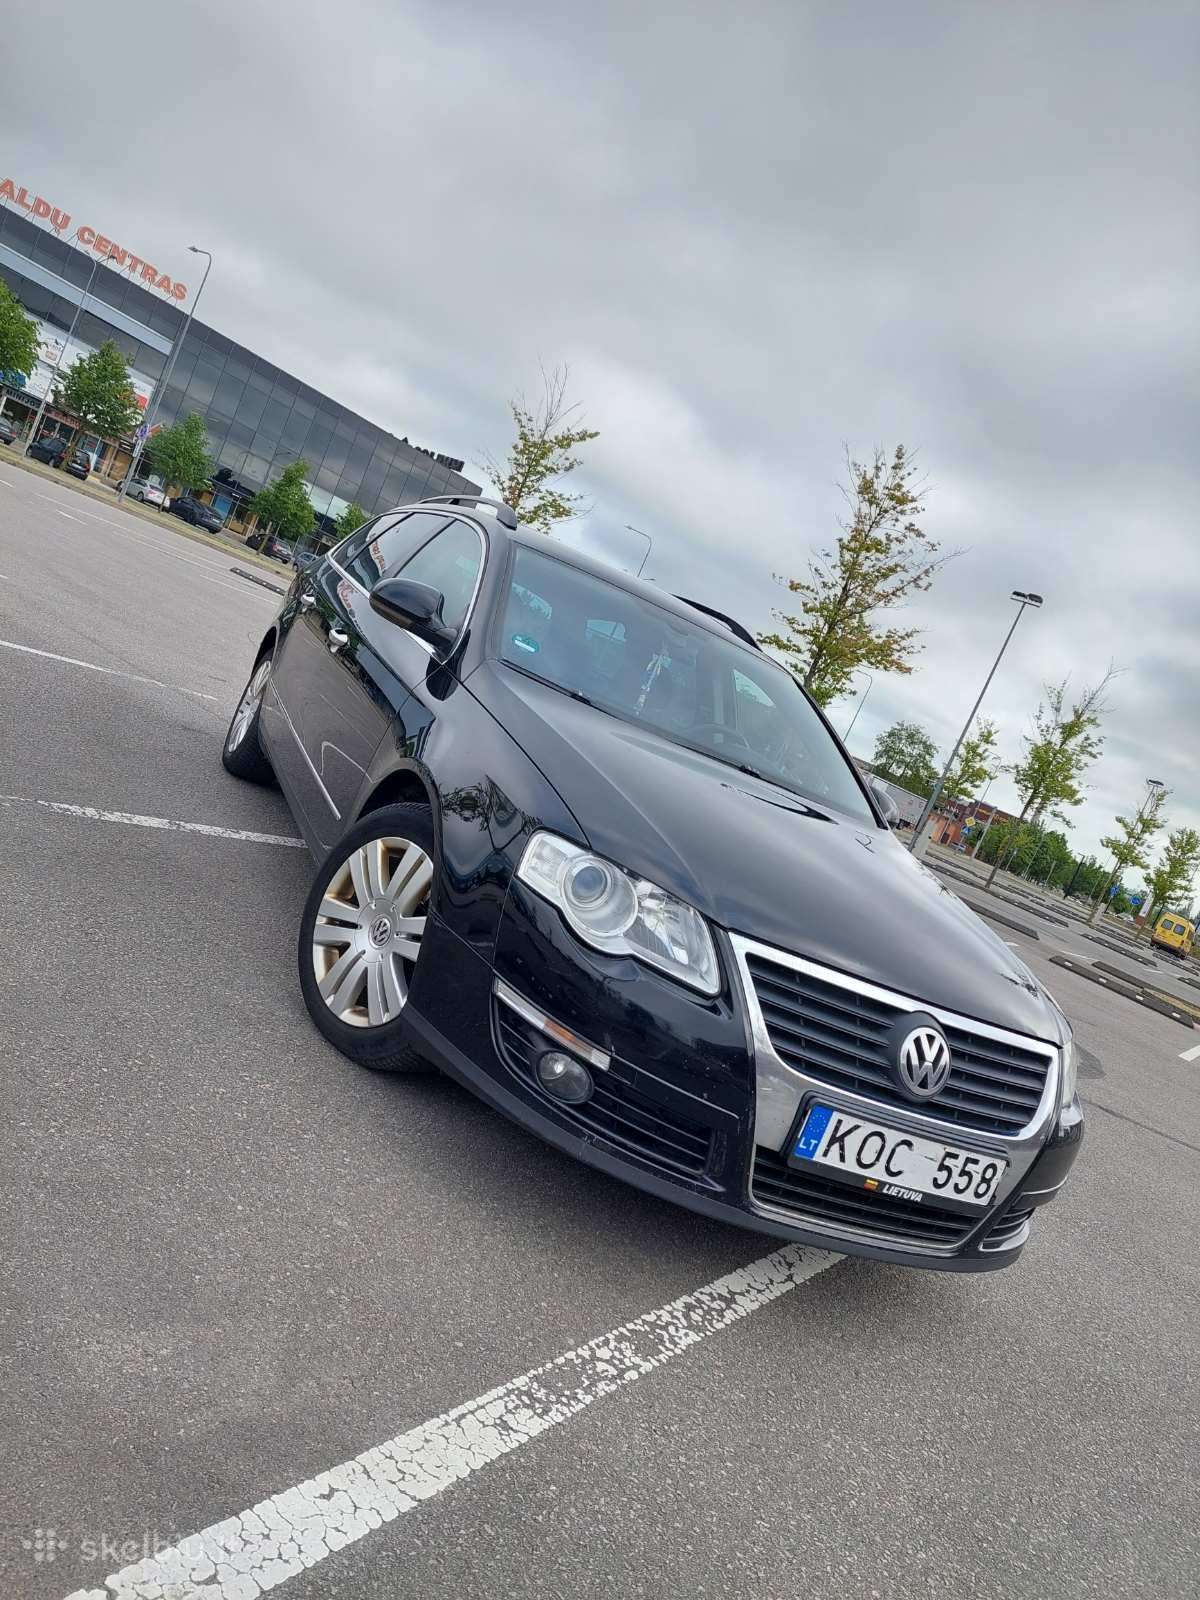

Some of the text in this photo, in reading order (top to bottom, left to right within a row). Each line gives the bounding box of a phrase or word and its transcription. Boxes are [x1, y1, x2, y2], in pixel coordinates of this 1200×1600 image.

[77, 226, 187, 300] CENTRAS
[799, 1119, 998, 1199] LT KOC 558
[882, 1183, 923, 1202] LIETUVA
